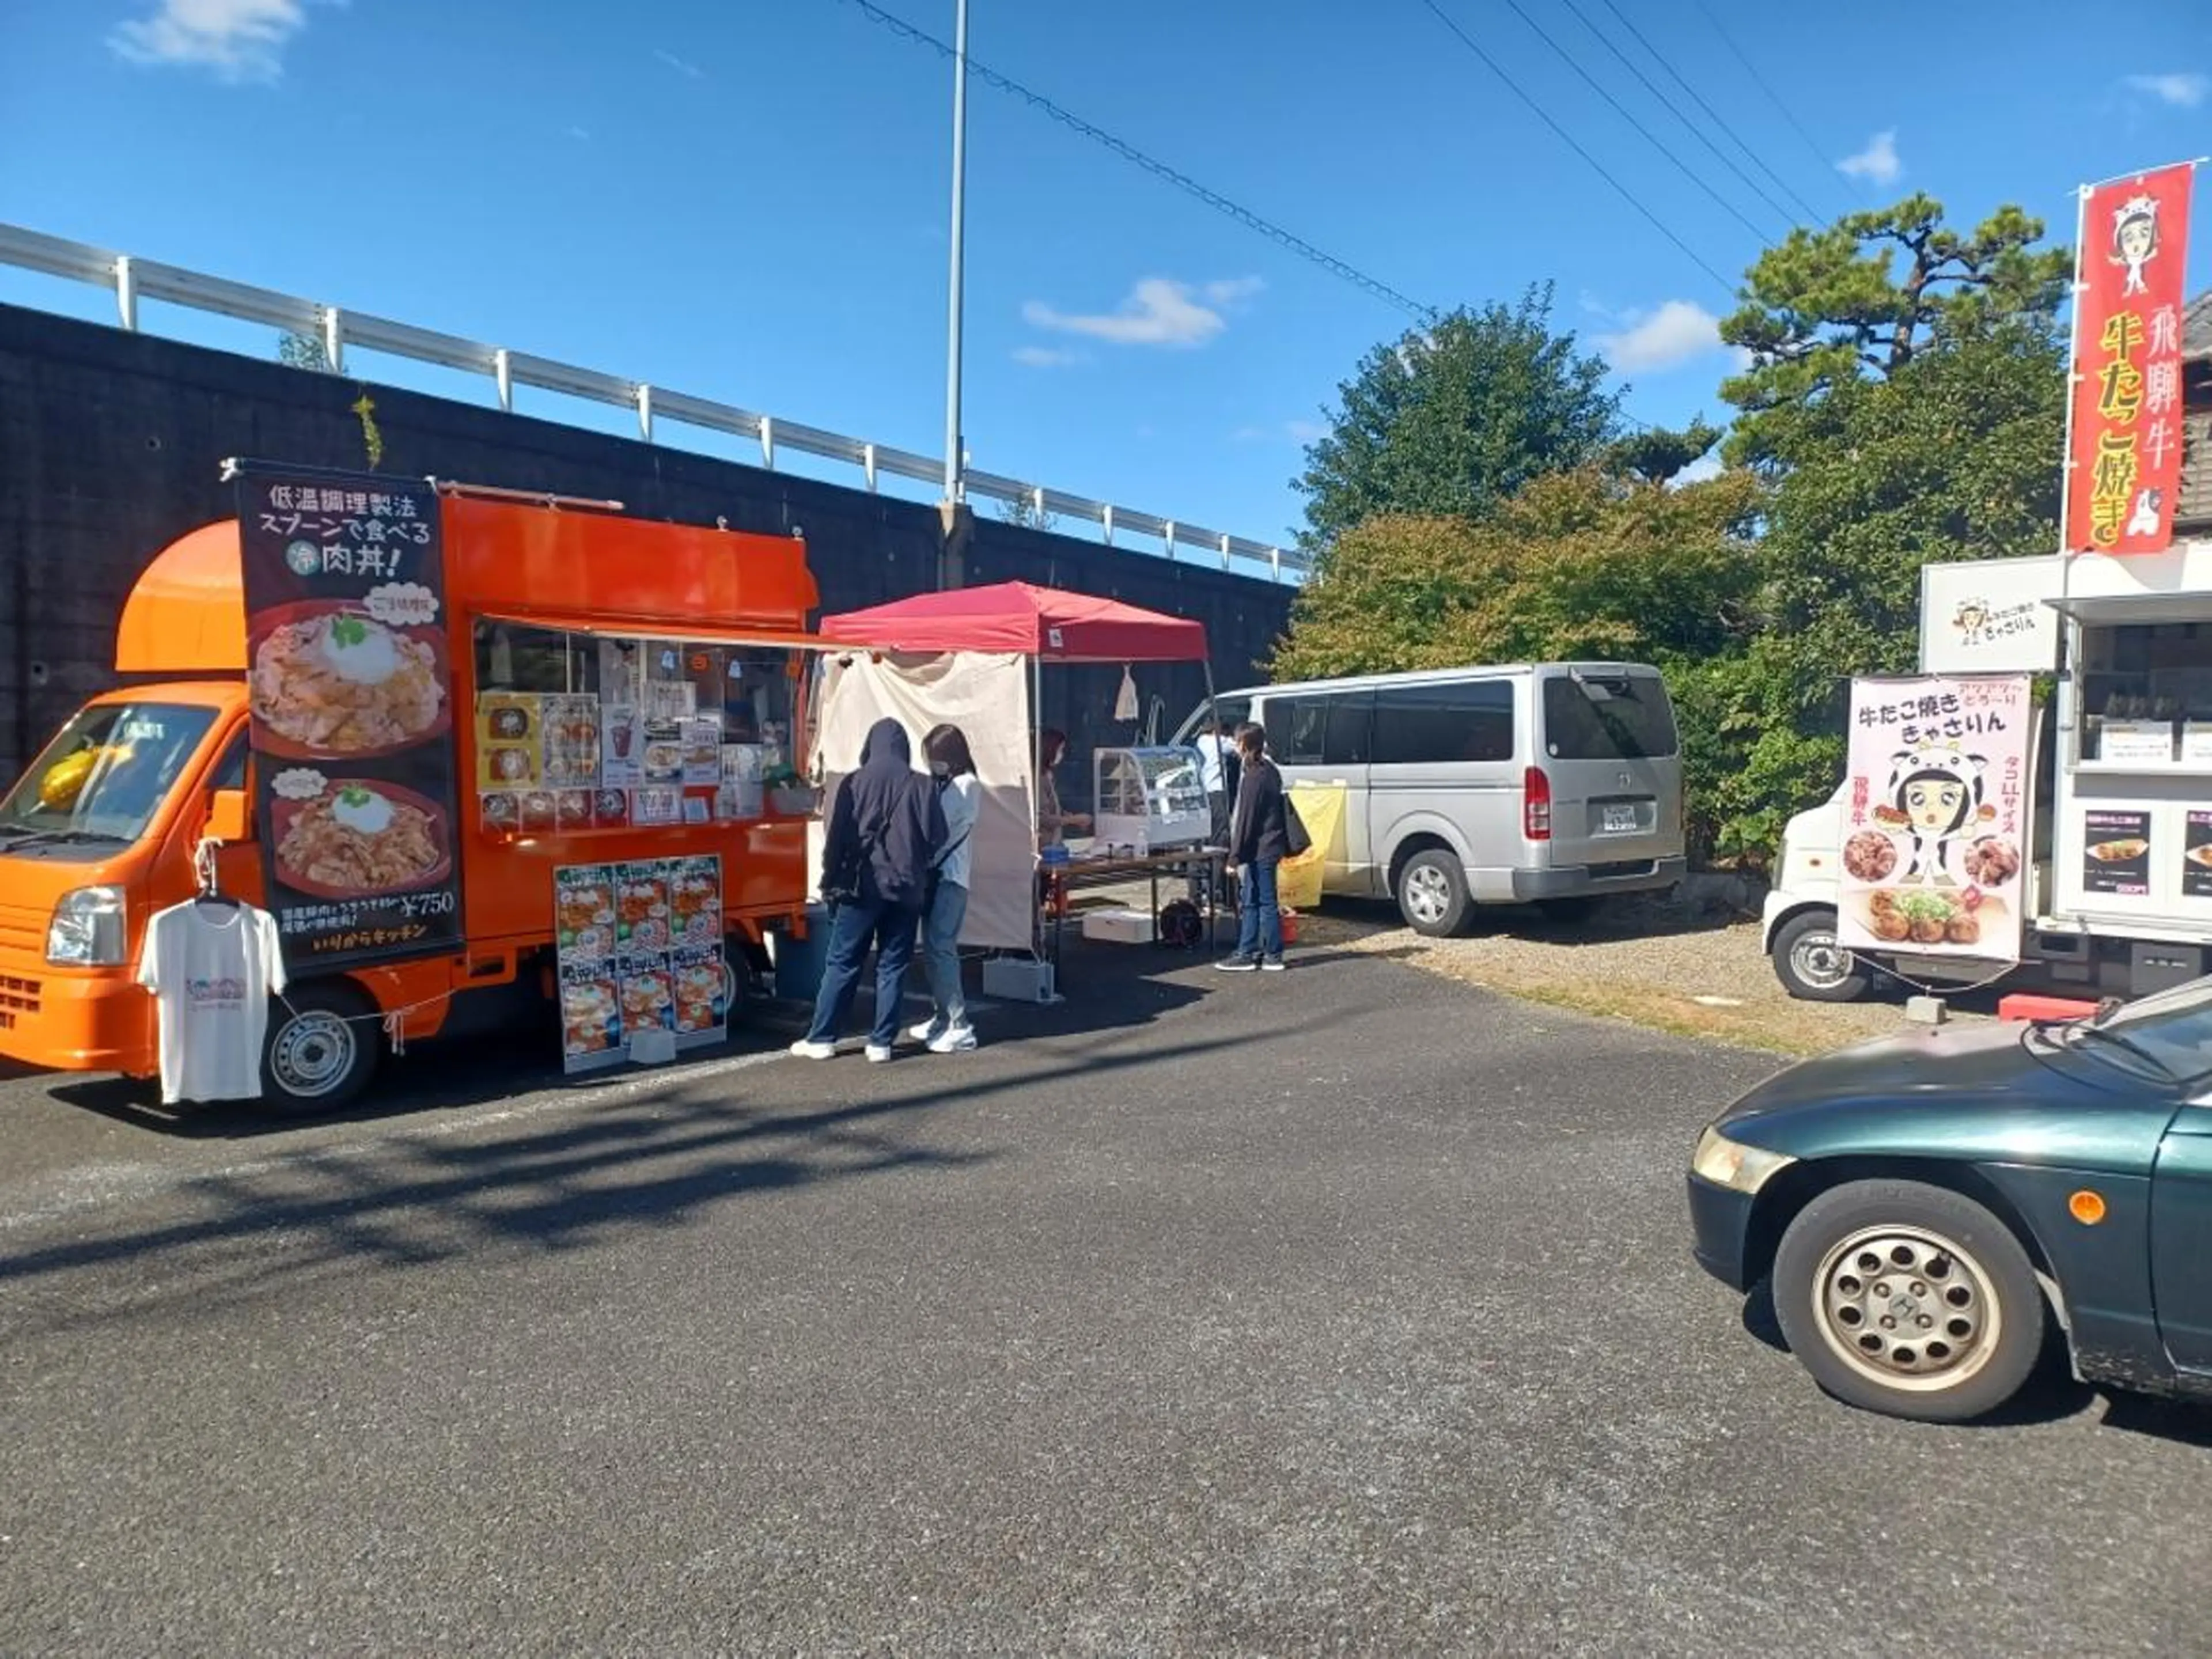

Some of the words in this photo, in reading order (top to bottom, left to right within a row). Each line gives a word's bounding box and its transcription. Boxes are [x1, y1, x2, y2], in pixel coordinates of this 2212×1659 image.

[269, 484, 417, 517] 低温調理製法
[260, 512, 430, 544] スプーンで食べる
[1902, 712, 2006, 744] きゃさりん
